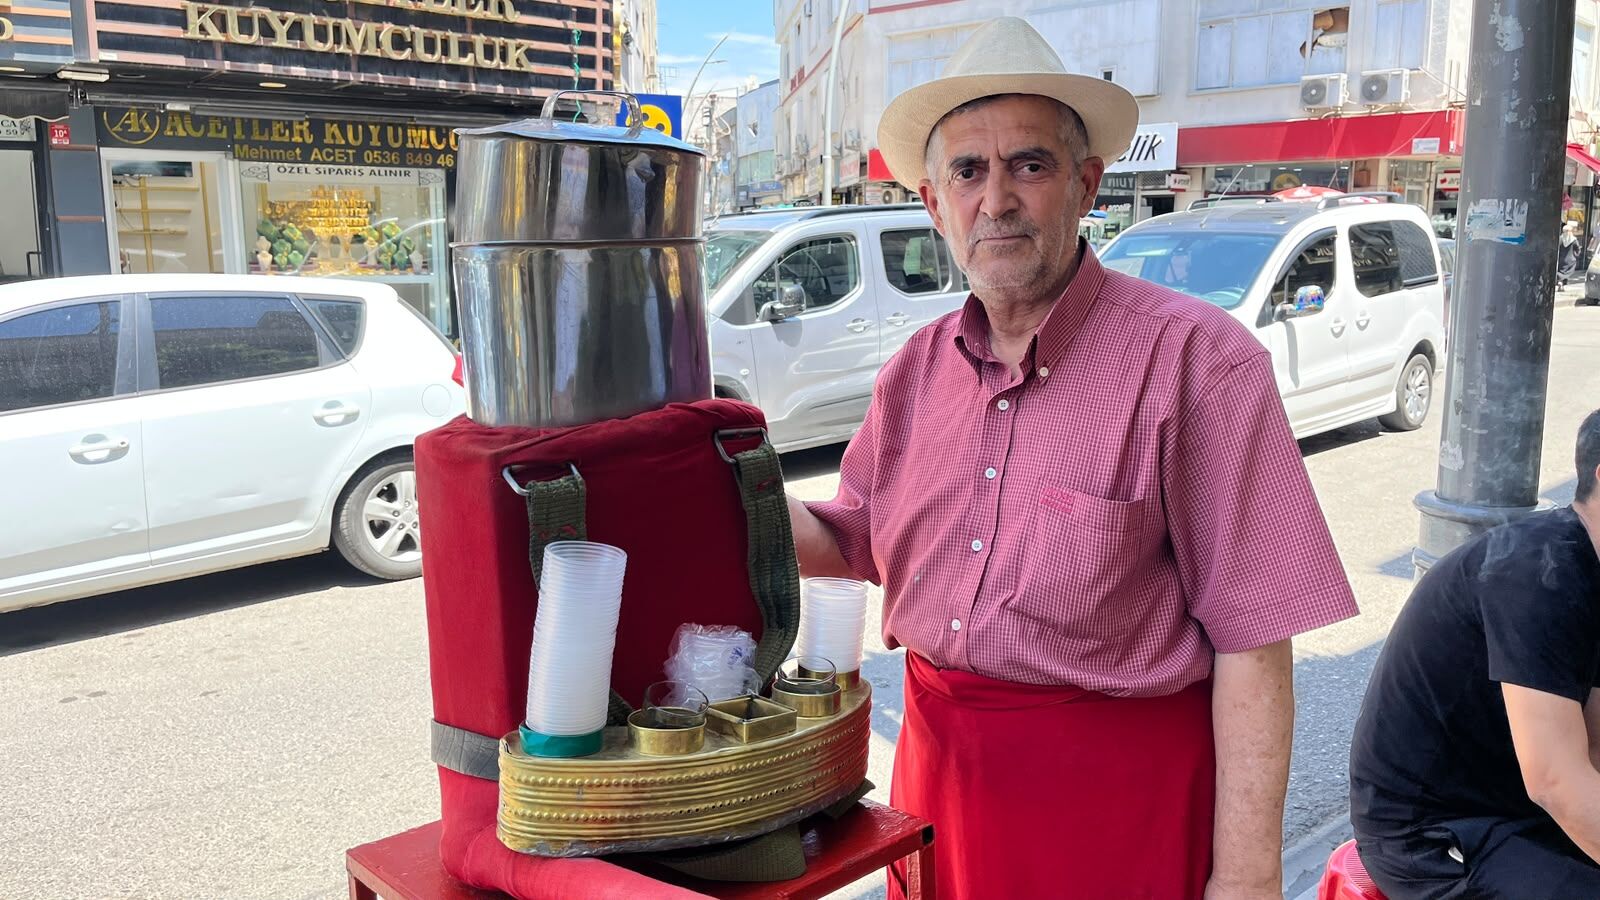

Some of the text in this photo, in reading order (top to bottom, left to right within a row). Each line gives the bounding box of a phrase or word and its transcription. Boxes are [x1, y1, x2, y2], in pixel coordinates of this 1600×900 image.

[183, 3, 533, 73] KUYUMCULUK
[234, 144, 455, 168] Mehmet ACET 0536 849 46
[369, 168, 412, 178] ALINIR
